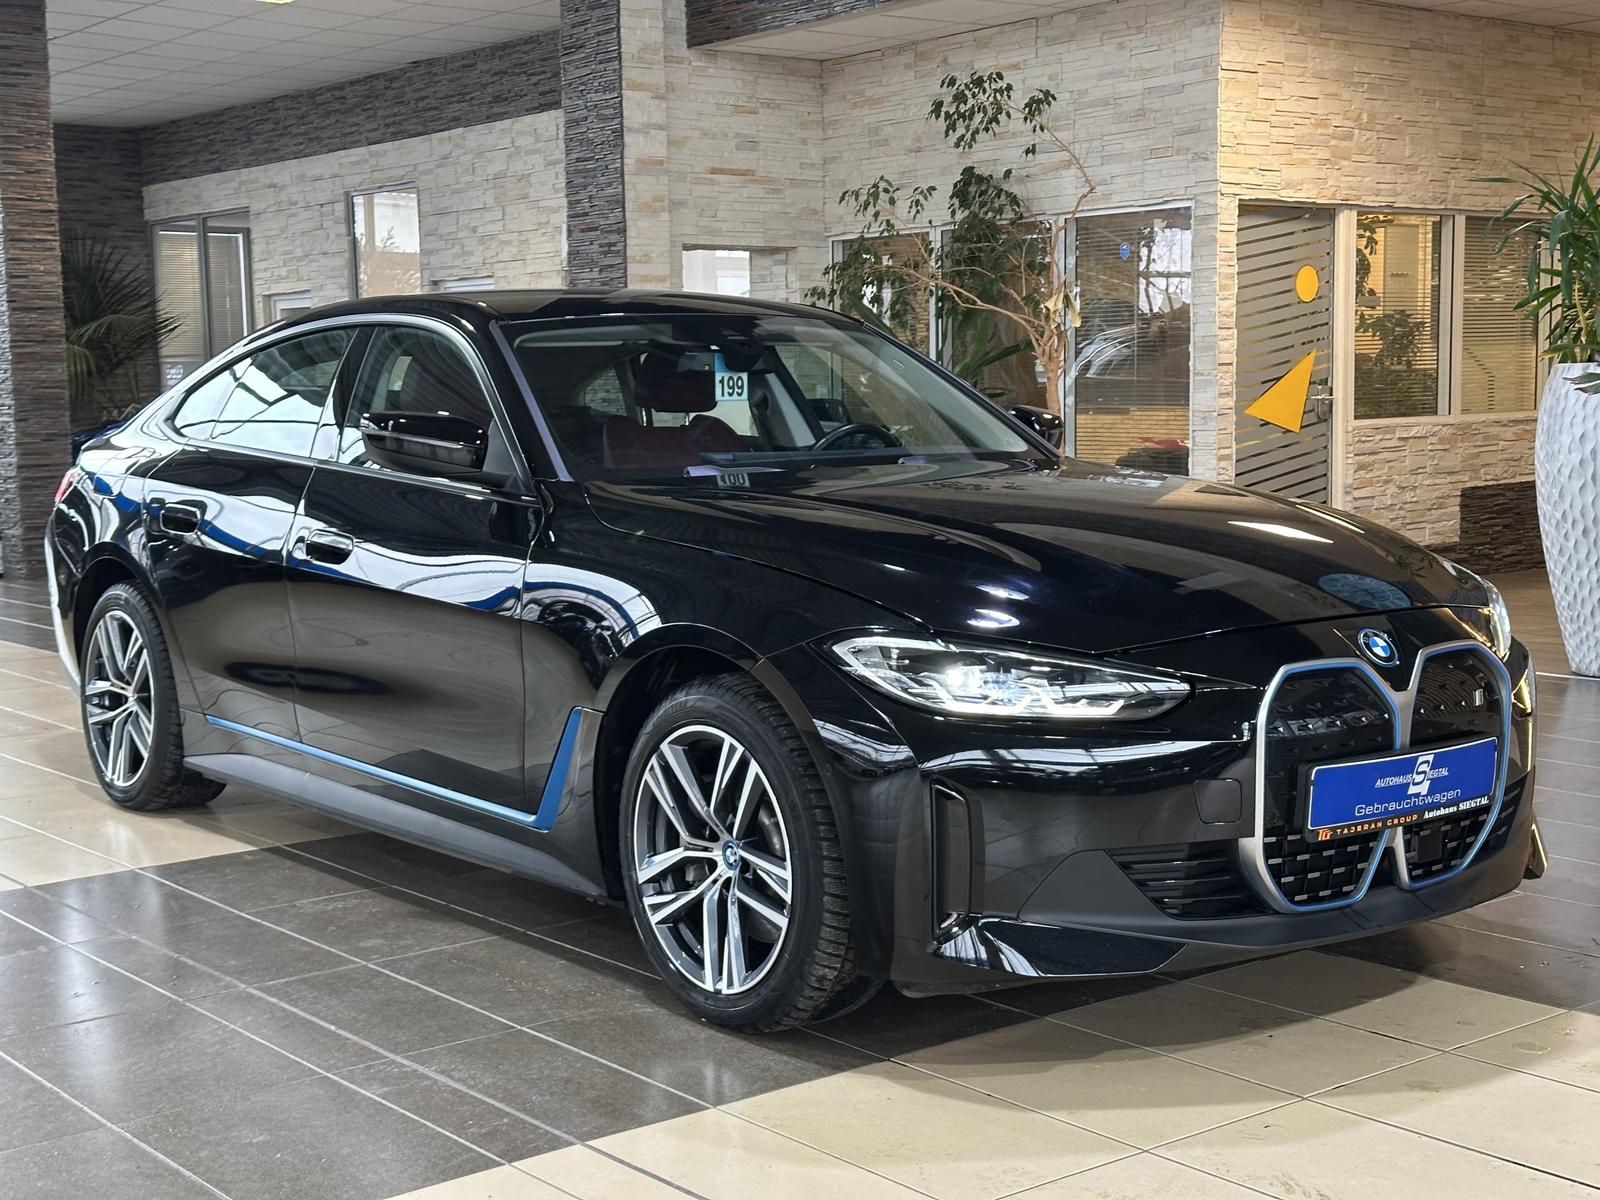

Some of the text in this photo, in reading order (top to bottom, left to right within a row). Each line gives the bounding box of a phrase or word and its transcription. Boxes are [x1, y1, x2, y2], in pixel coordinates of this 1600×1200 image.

[718, 375, 745, 397] 199
[1375, 773, 1413, 788] AUTOHAUS
[1354, 789, 1461, 816] Gebrauchtwagen
[1423, 796, 1490, 820] Autohaus SIEGTAL
[1336, 821, 1382, 836] TAJERAN
[1386, 814, 1418, 826] GROUP
